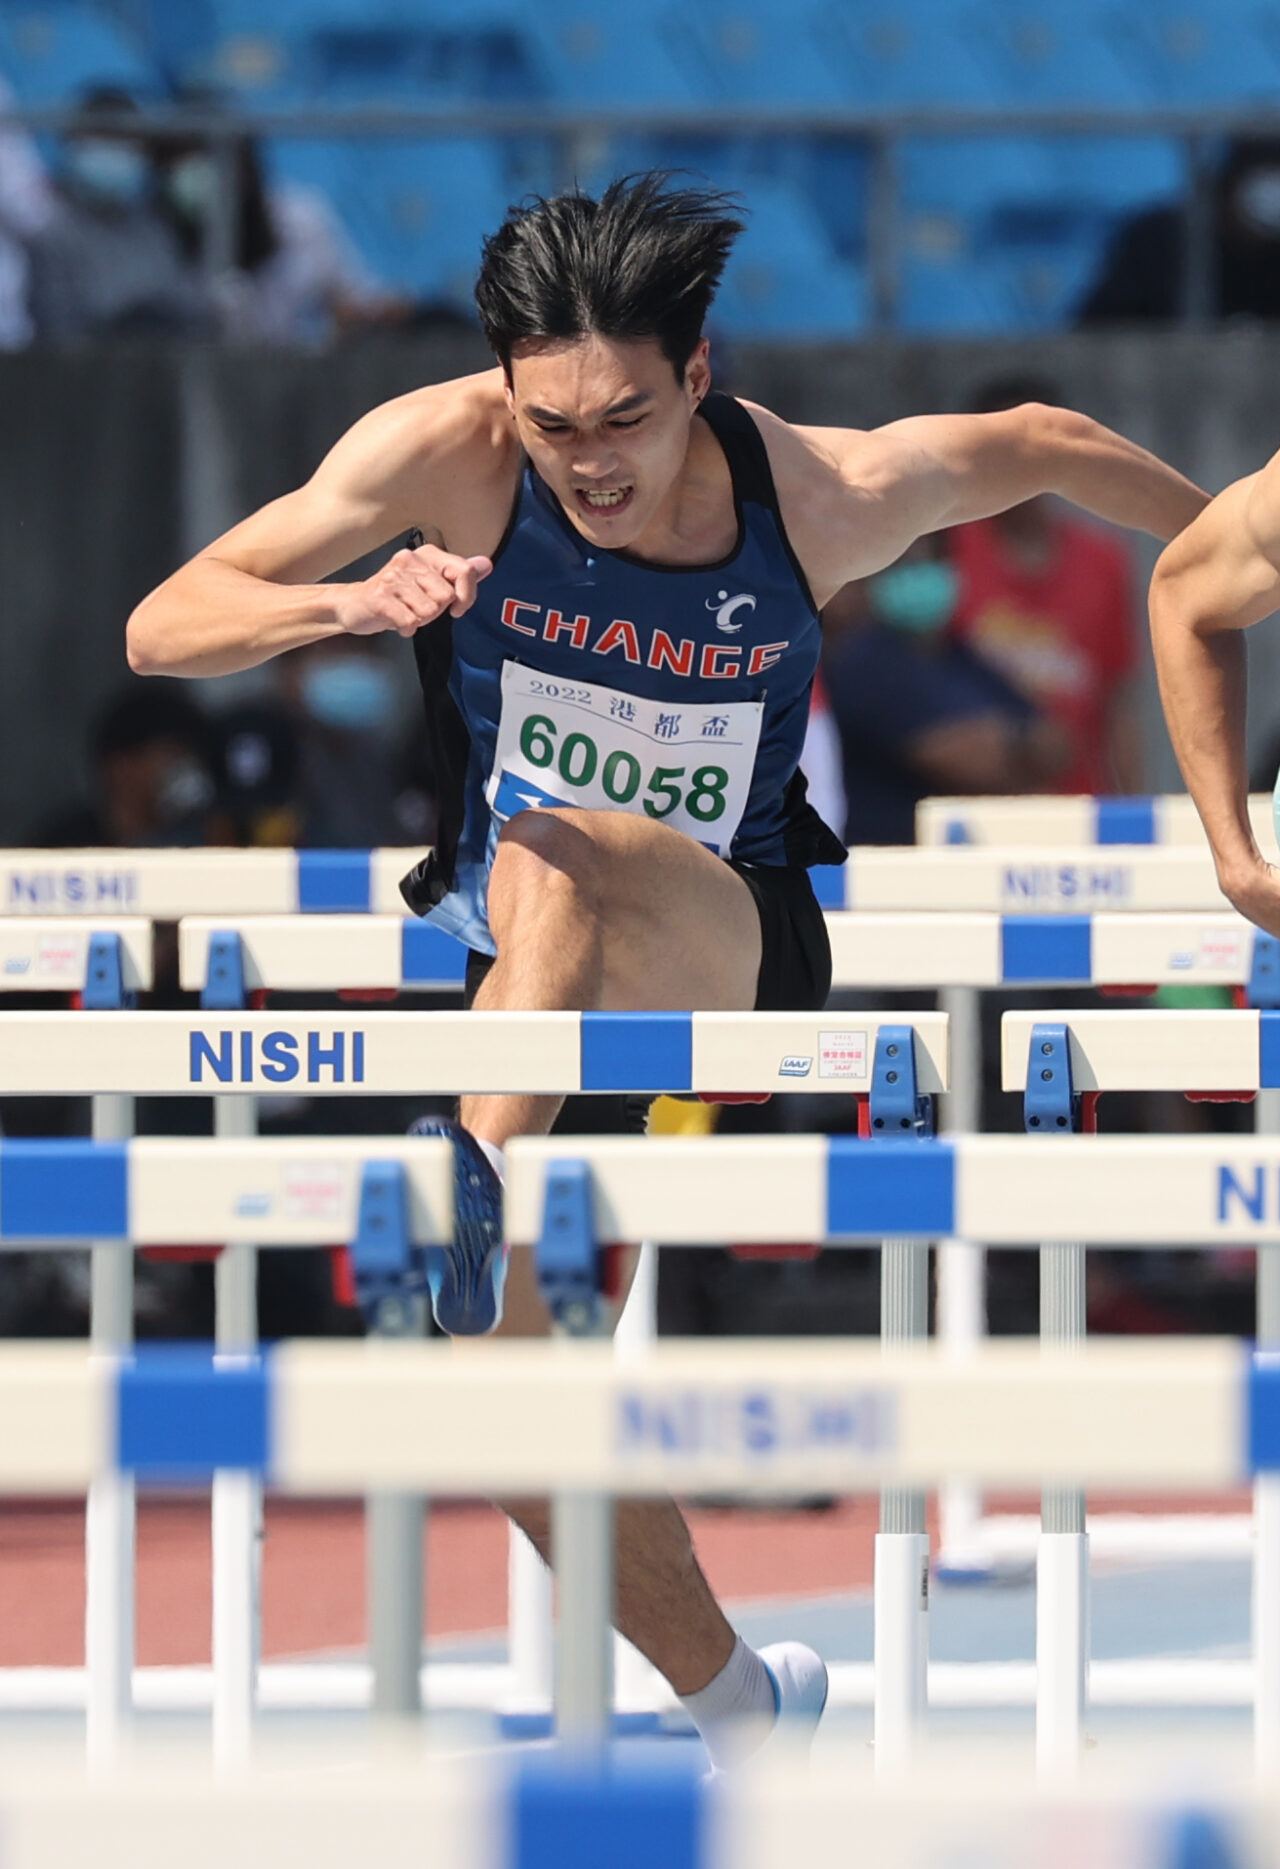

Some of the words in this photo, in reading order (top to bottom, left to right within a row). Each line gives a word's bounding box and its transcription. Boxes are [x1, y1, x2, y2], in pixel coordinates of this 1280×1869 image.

[501, 598, 790, 679] CHANGE
[530, 680, 592, 705] 2022
[520, 714, 729, 822] 60058
[10, 868, 137, 903] NISHI
[189, 1030, 366, 1083] NISHI
